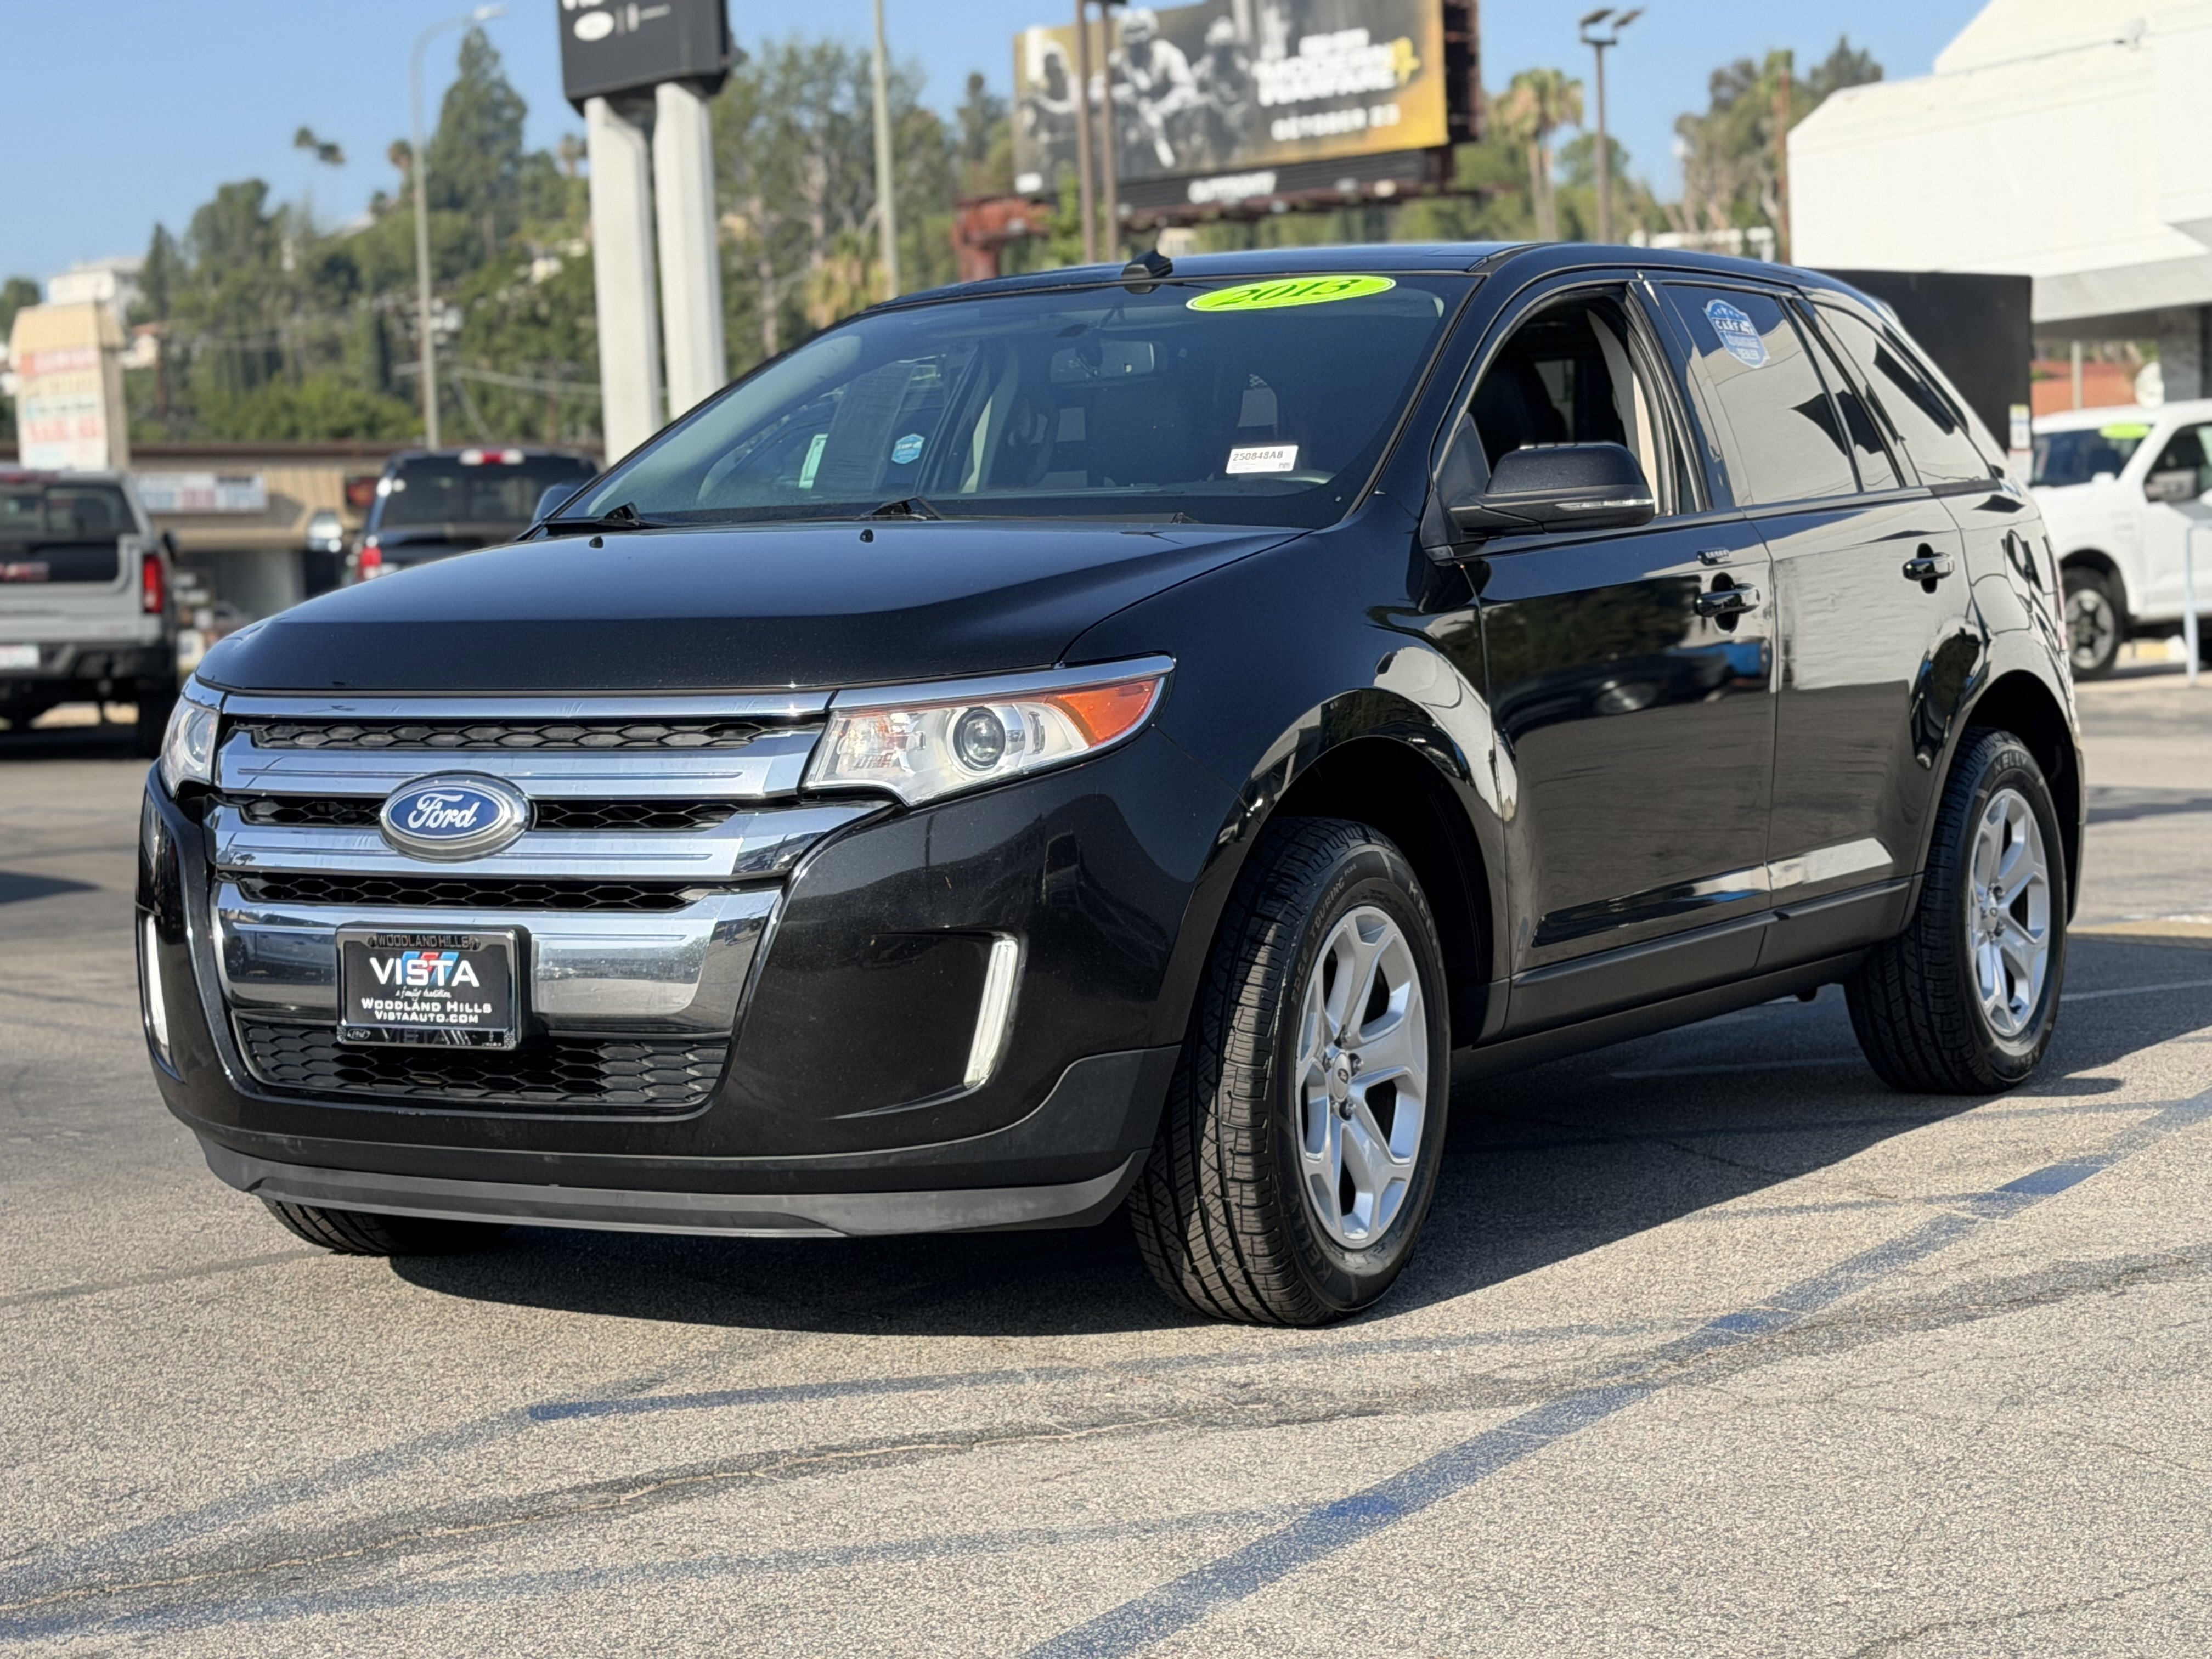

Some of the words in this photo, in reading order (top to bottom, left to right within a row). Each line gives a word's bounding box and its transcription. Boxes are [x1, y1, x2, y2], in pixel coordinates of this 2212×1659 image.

[1210, 279, 1362, 307] 2013
[1233, 450, 1284, 461] 250848AB
[407, 793, 481, 829] Ford
[1308, 877, 1346, 939] TOURING
[377, 934, 437, 947] WOODLAND
[438, 935, 469, 948] HILLS
[370, 957, 481, 988] VISTA
